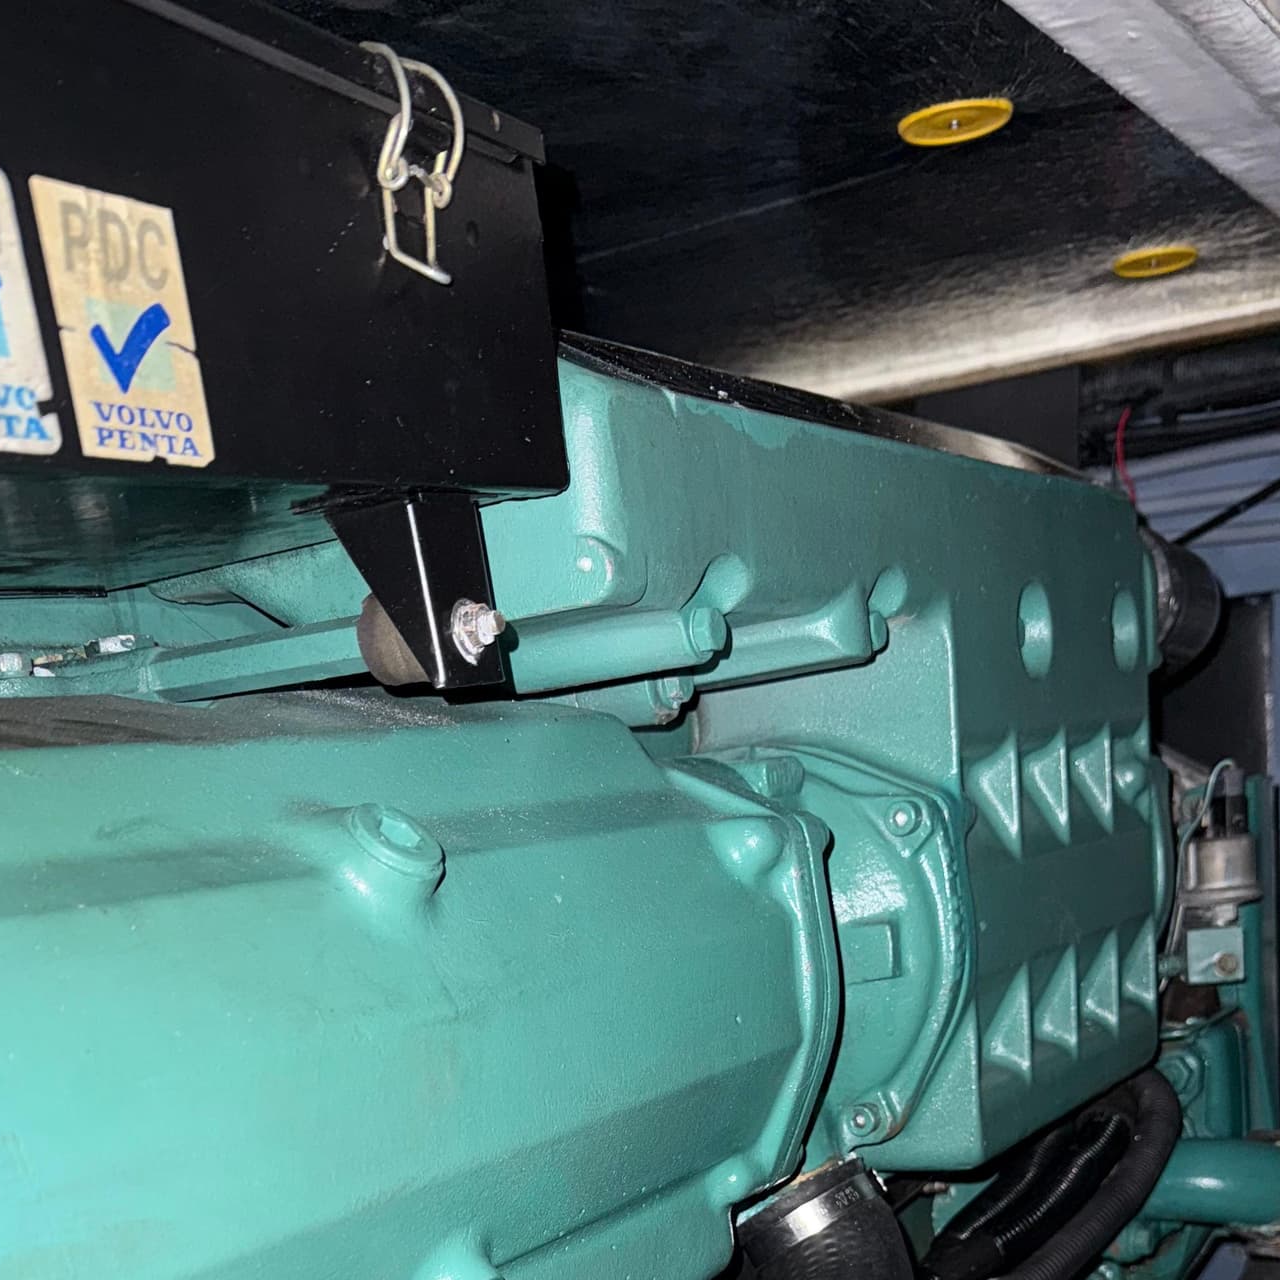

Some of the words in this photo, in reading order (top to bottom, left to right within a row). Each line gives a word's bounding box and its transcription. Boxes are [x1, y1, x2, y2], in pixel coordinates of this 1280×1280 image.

[59, 200, 170, 291] PDC
[90, 400, 194, 433] VOLVO
[94, 426, 204, 458] PENTA
